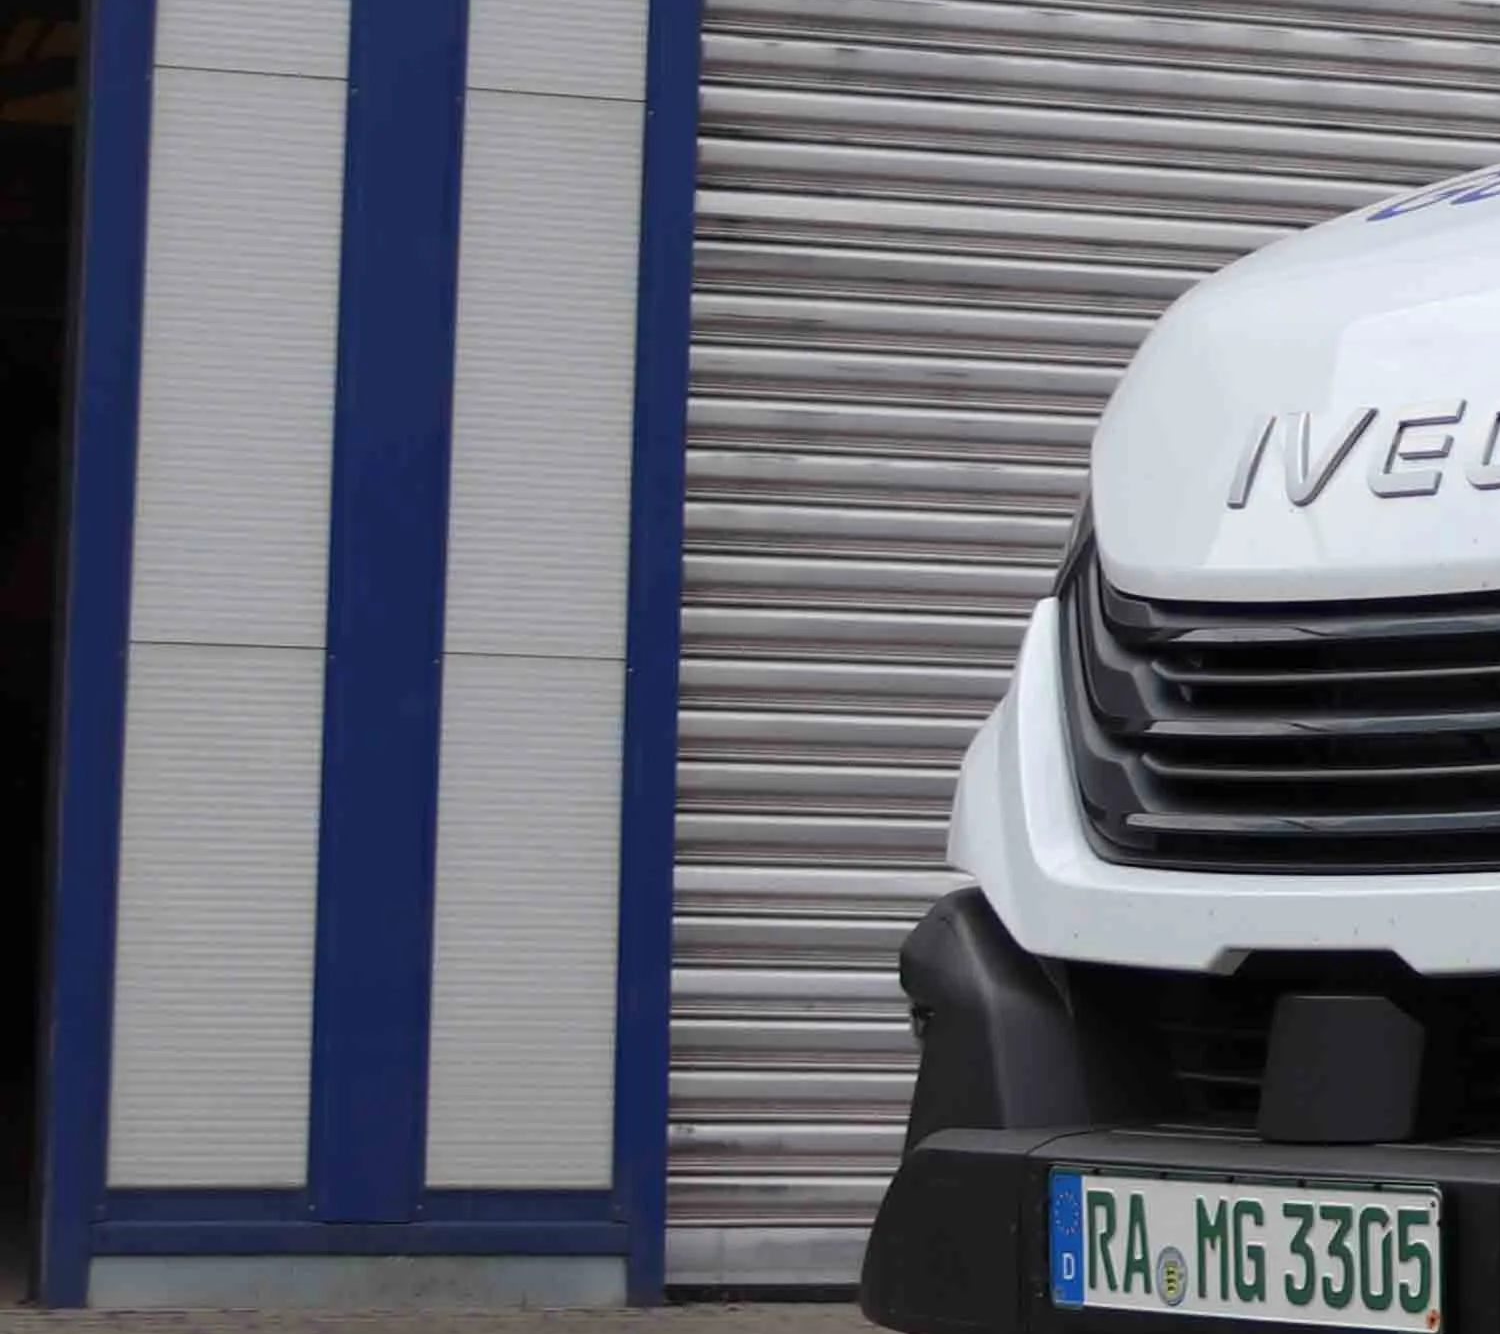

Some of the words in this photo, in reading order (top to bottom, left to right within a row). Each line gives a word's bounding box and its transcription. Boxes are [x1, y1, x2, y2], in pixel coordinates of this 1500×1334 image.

[1062, 1252, 1074, 1281] D
[1087, 1189, 1153, 1295] RA
[1196, 1196, 1267, 1303] MG
[1282, 1202, 1431, 1314] 3305
